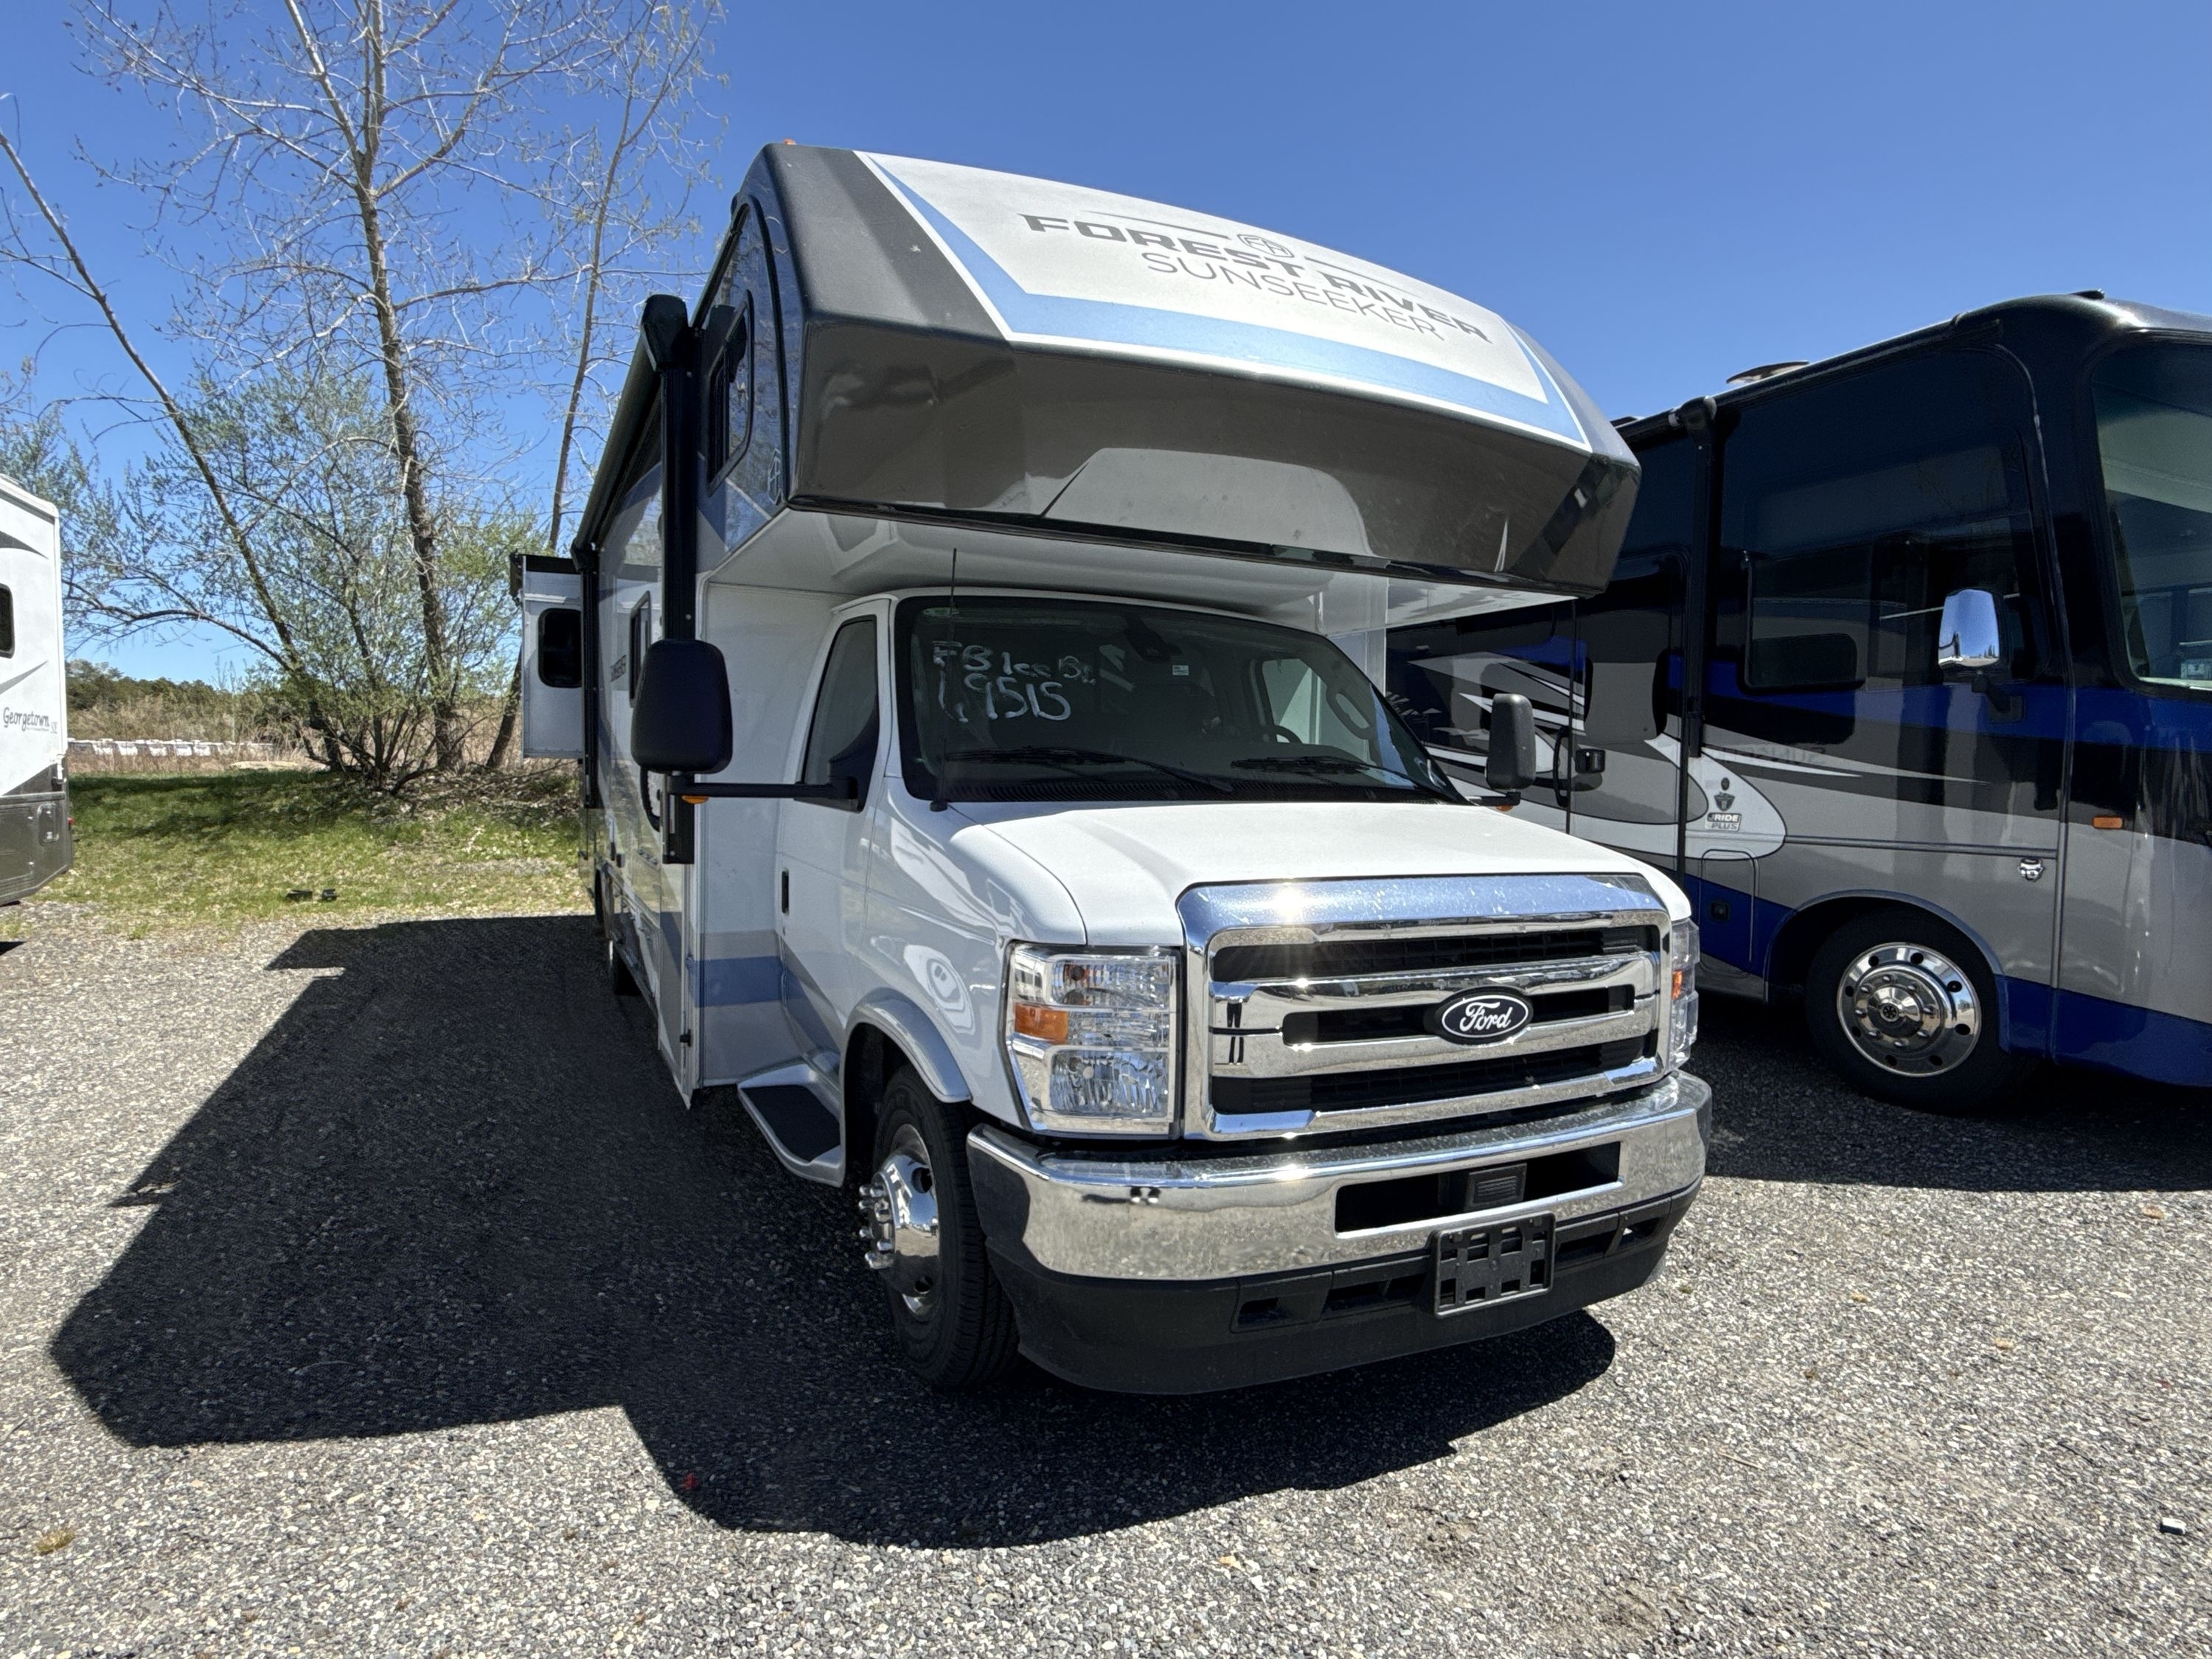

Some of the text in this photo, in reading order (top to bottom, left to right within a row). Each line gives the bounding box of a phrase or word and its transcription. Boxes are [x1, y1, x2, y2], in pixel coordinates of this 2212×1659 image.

[1017, 212, 1493, 344] FOREST RIVER
[1141, 251, 1445, 341] SUNSEEKER
[3, 706, 50, 731] Georgetown
[1711, 821, 1738, 830] PLUS
[1459, 1001, 1513, 1032] Ford
